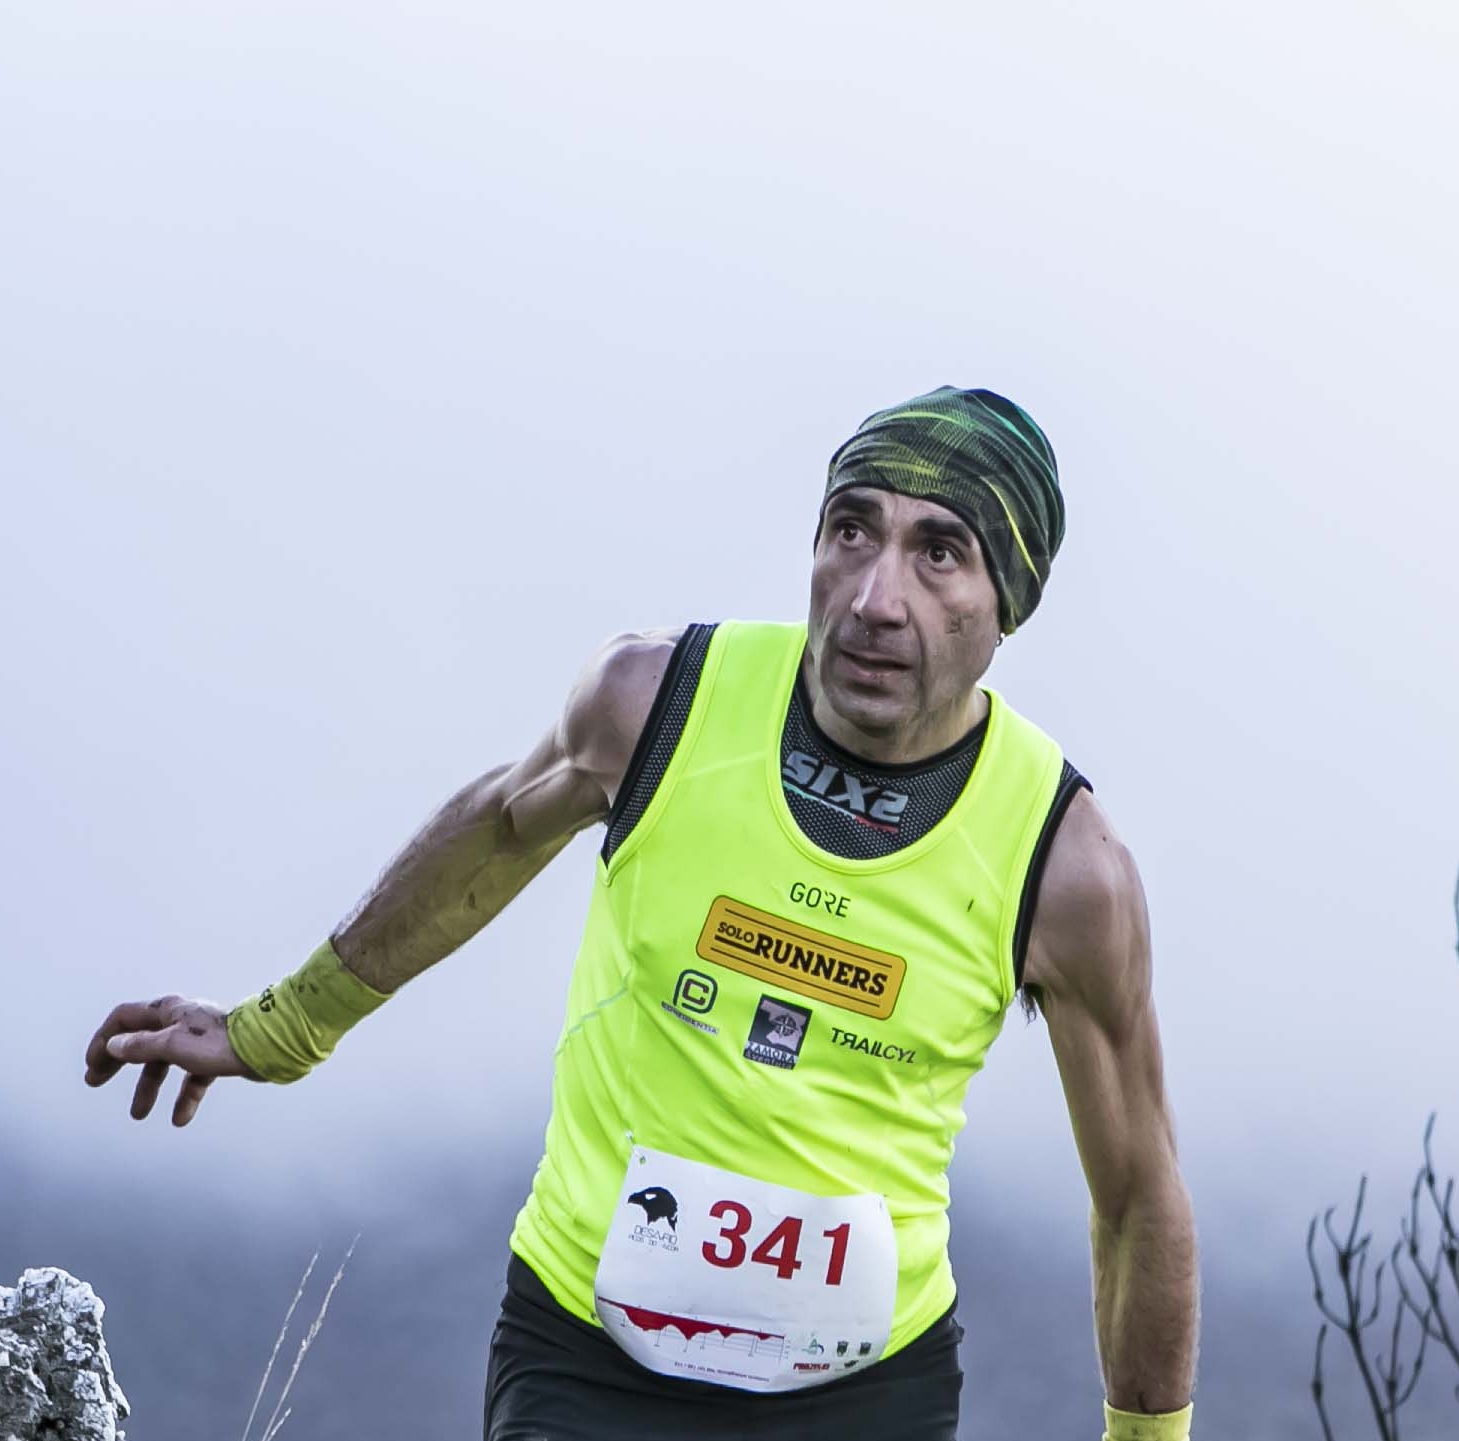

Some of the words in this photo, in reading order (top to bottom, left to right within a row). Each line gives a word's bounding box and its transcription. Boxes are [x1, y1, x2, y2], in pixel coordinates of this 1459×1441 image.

[790, 882, 851, 918] GORE
[717, 920, 754, 945] SOLO
[753, 933, 889, 998] RUNNERS
[746, 1041, 798, 1064] ZAMORA
[702, 1200, 851, 1287] 341
